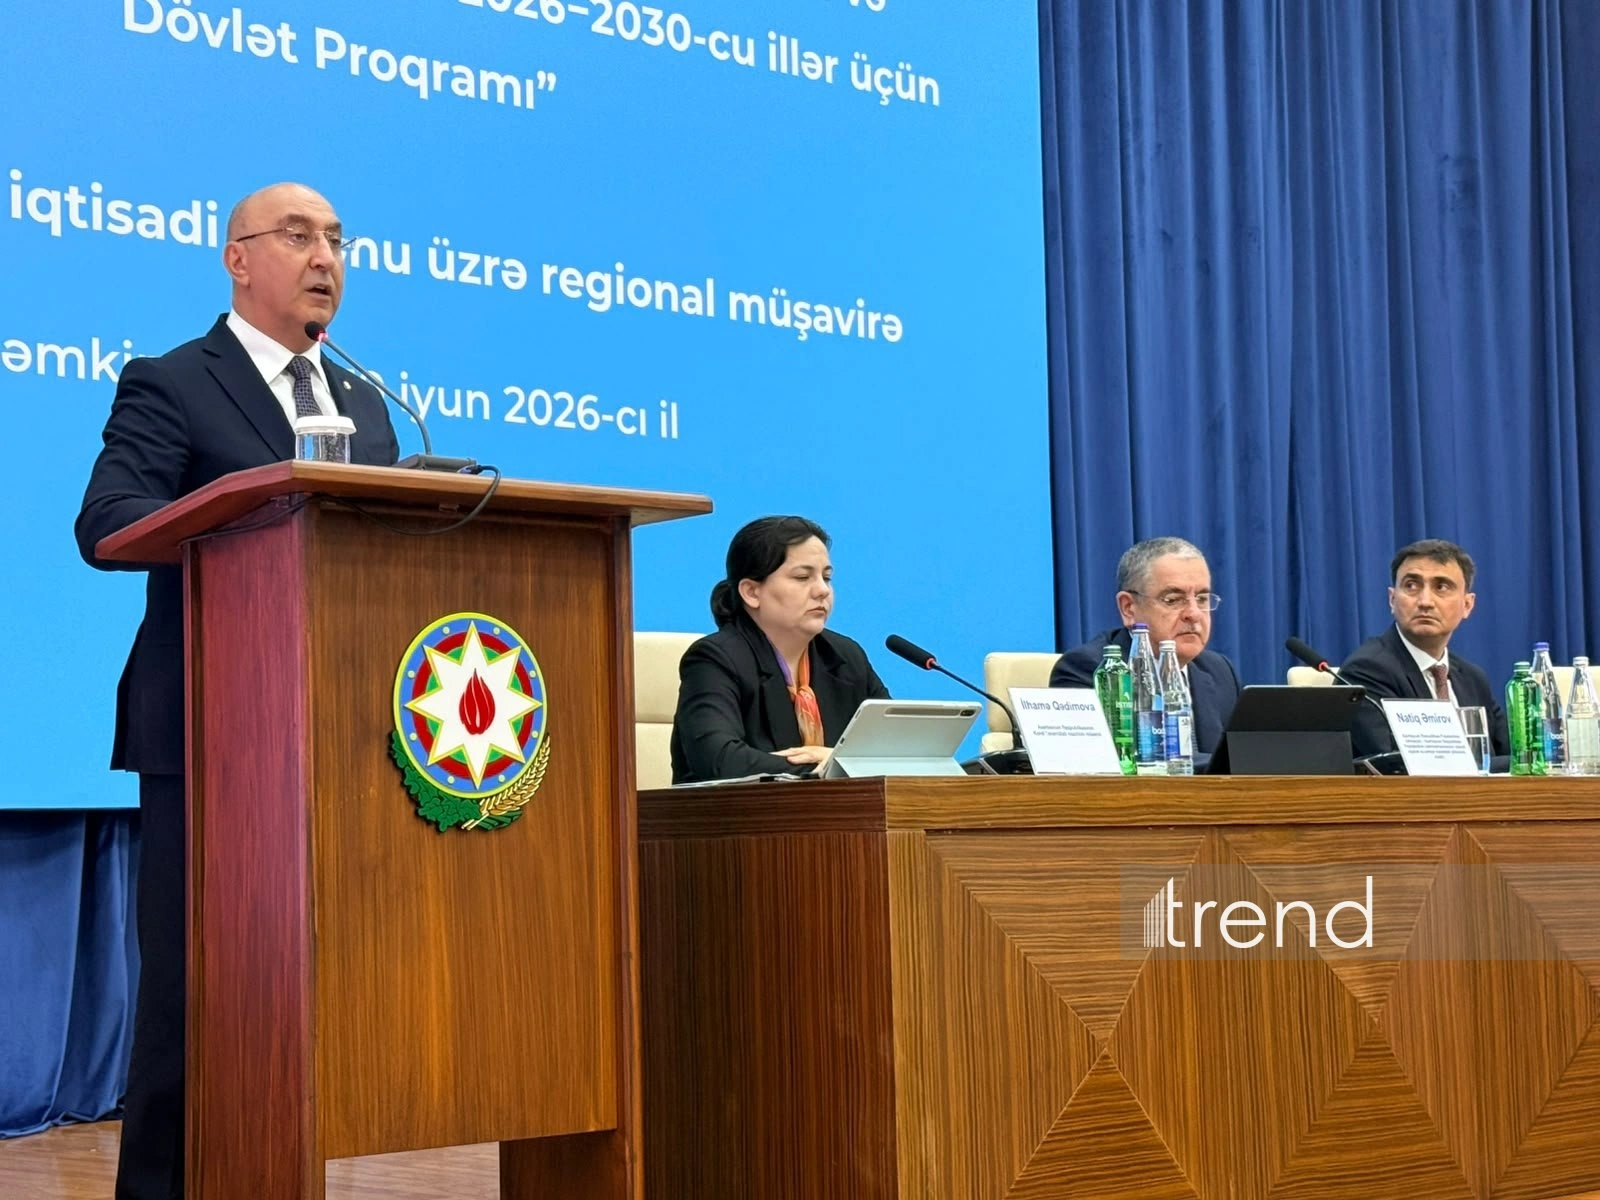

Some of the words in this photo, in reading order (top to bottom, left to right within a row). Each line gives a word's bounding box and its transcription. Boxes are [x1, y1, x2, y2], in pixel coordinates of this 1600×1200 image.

[124, 0, 299, 64] Dövlət
[767, 31, 839, 84] illər
[851, 52, 940, 106] üçün
[9, 169, 218, 248] iqtisadi
[428, 236, 528, 290] üzrə
[542, 262, 715, 317] regional
[729, 287, 903, 342] müşavirə
[400, 371, 490, 424] iyun
[503, 385, 647, 436] 2026-cı
[660, 400, 678, 439] il
[1396, 712, 1422, 725] Natiq
